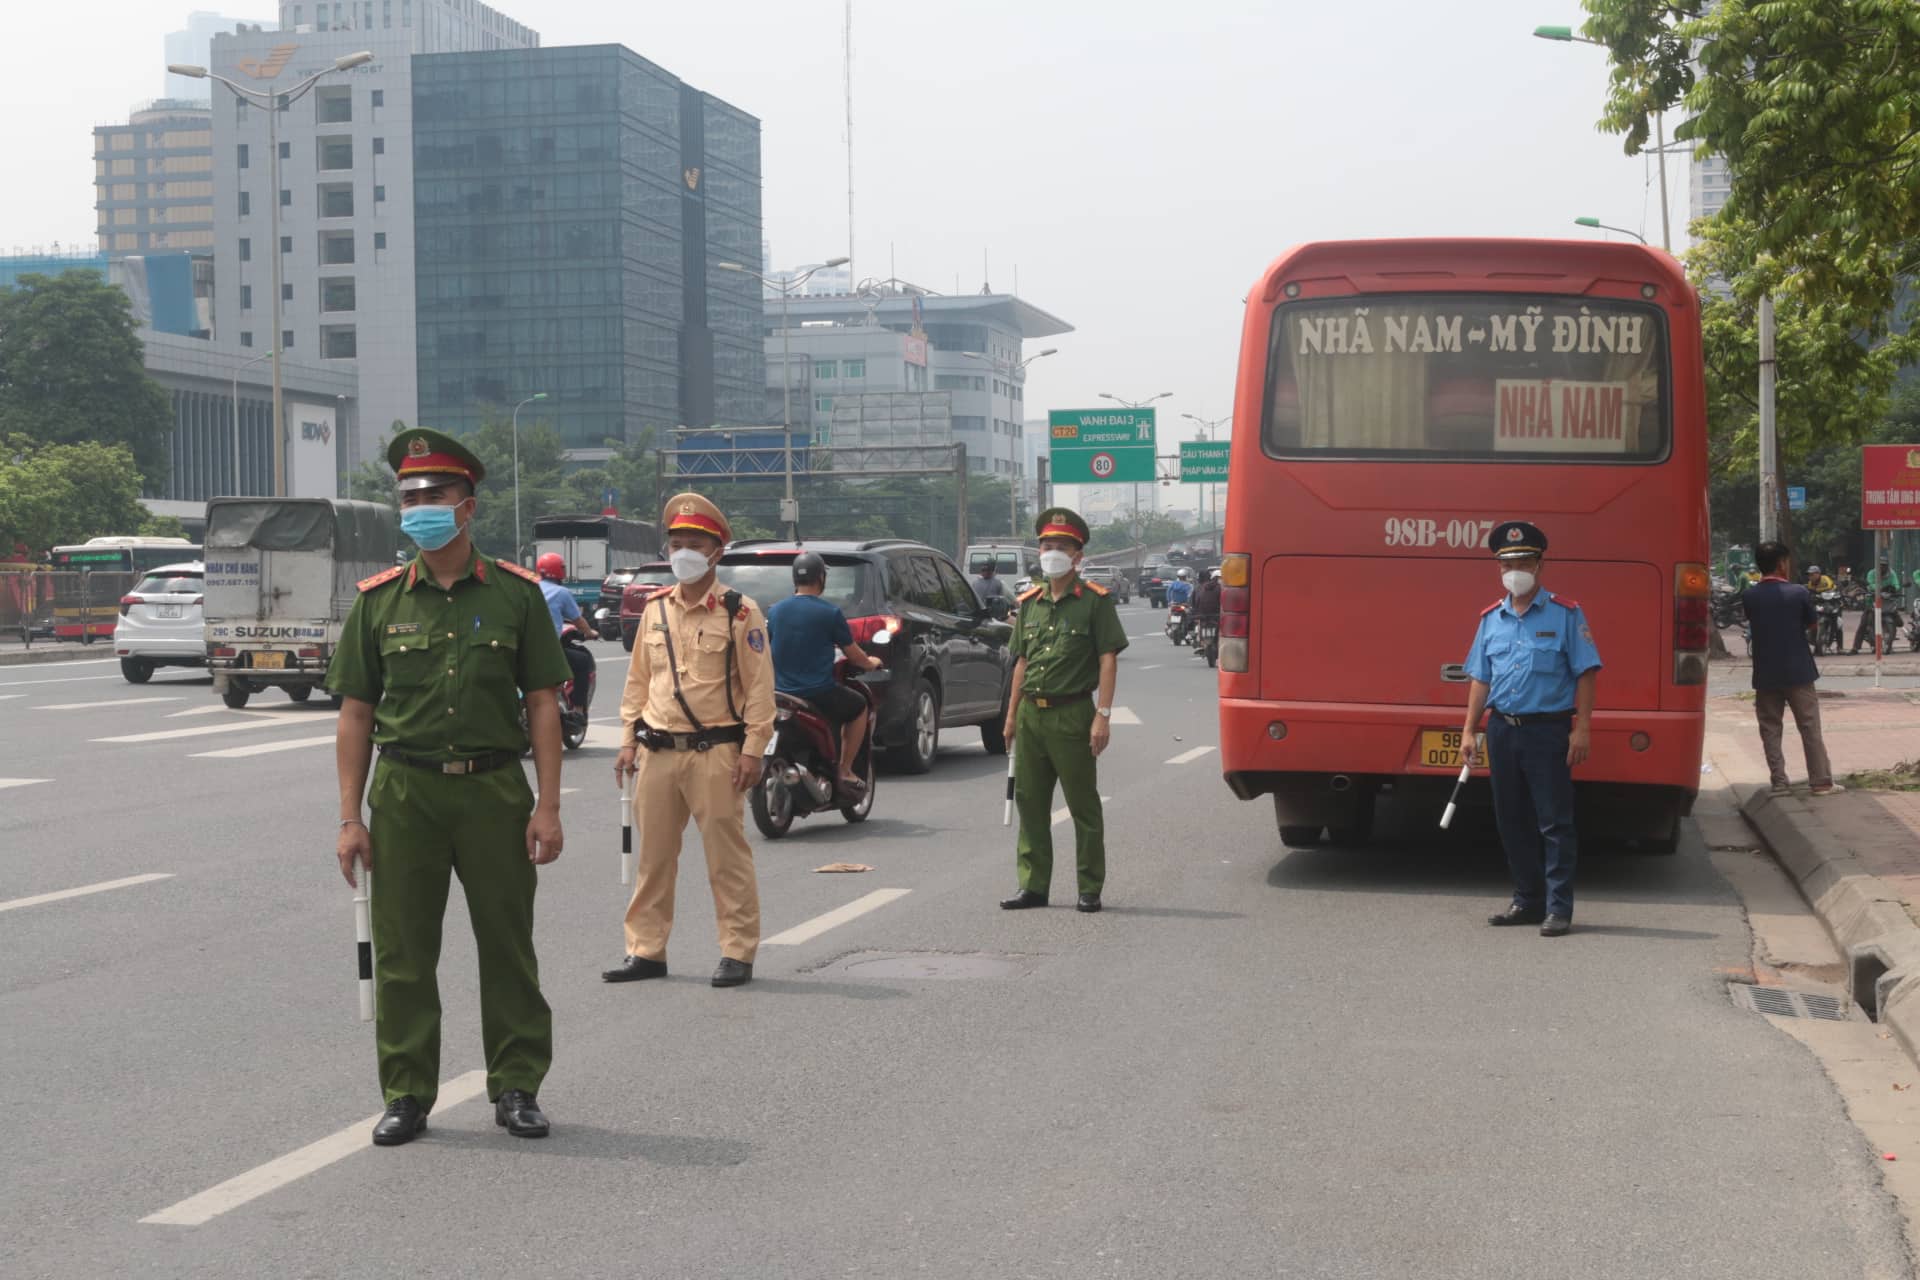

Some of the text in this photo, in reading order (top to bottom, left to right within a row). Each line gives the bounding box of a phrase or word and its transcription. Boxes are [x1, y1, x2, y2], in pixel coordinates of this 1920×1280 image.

[1299, 306, 1643, 354] NHÃ NAM MỸ ĐÌNH
[1500, 378, 1624, 440] NHÃ NAM
[1096, 461, 1110, 471] 80
[1385, 517, 1510, 549] 98B-007
[235, 626, 298, 638] SUZUKI
